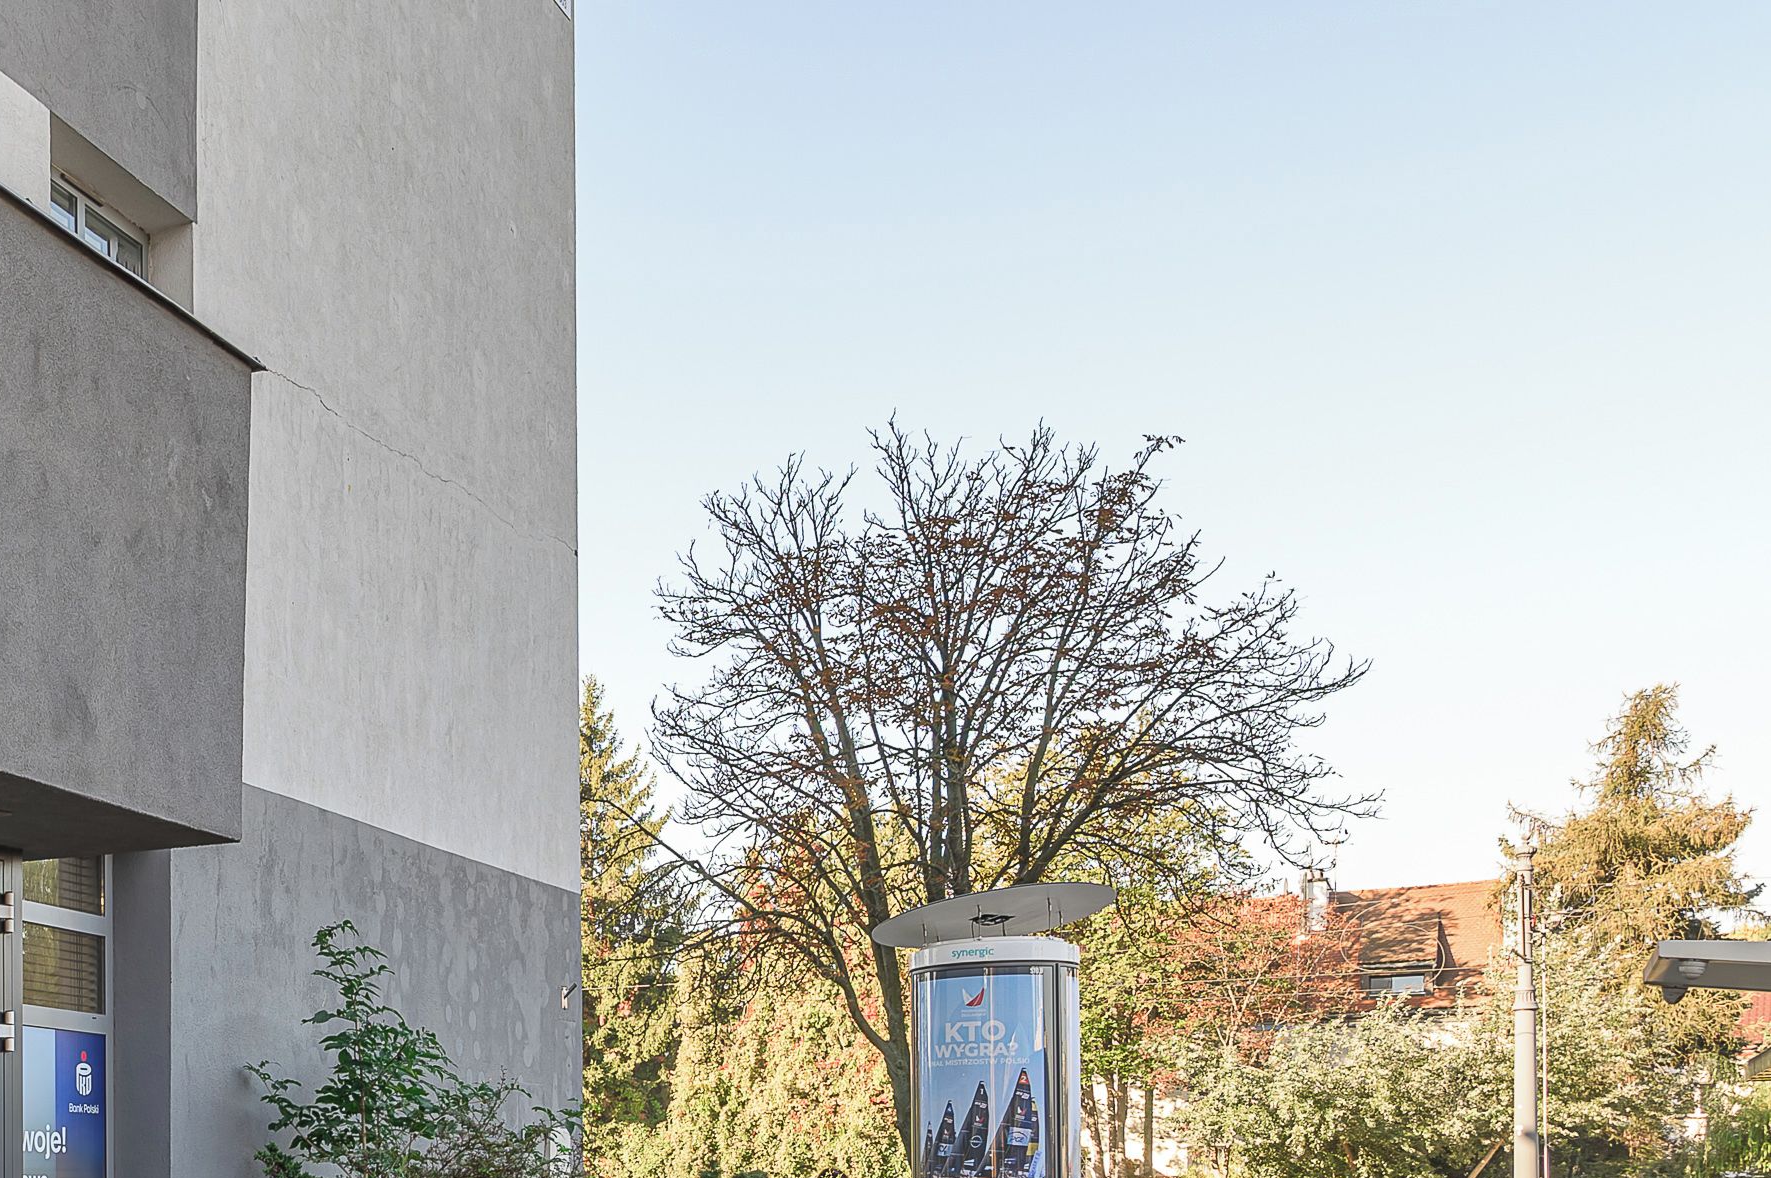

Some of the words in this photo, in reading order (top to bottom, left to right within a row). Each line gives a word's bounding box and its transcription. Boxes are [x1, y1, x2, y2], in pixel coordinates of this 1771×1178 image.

[951, 946, 994, 960] synergic
[944, 1020, 1006, 1043] KTO
[68, 1102, 83, 1113] Bank
[83, 1104, 99, 1114] Polski
[23, 1124, 67, 1160] woje!
